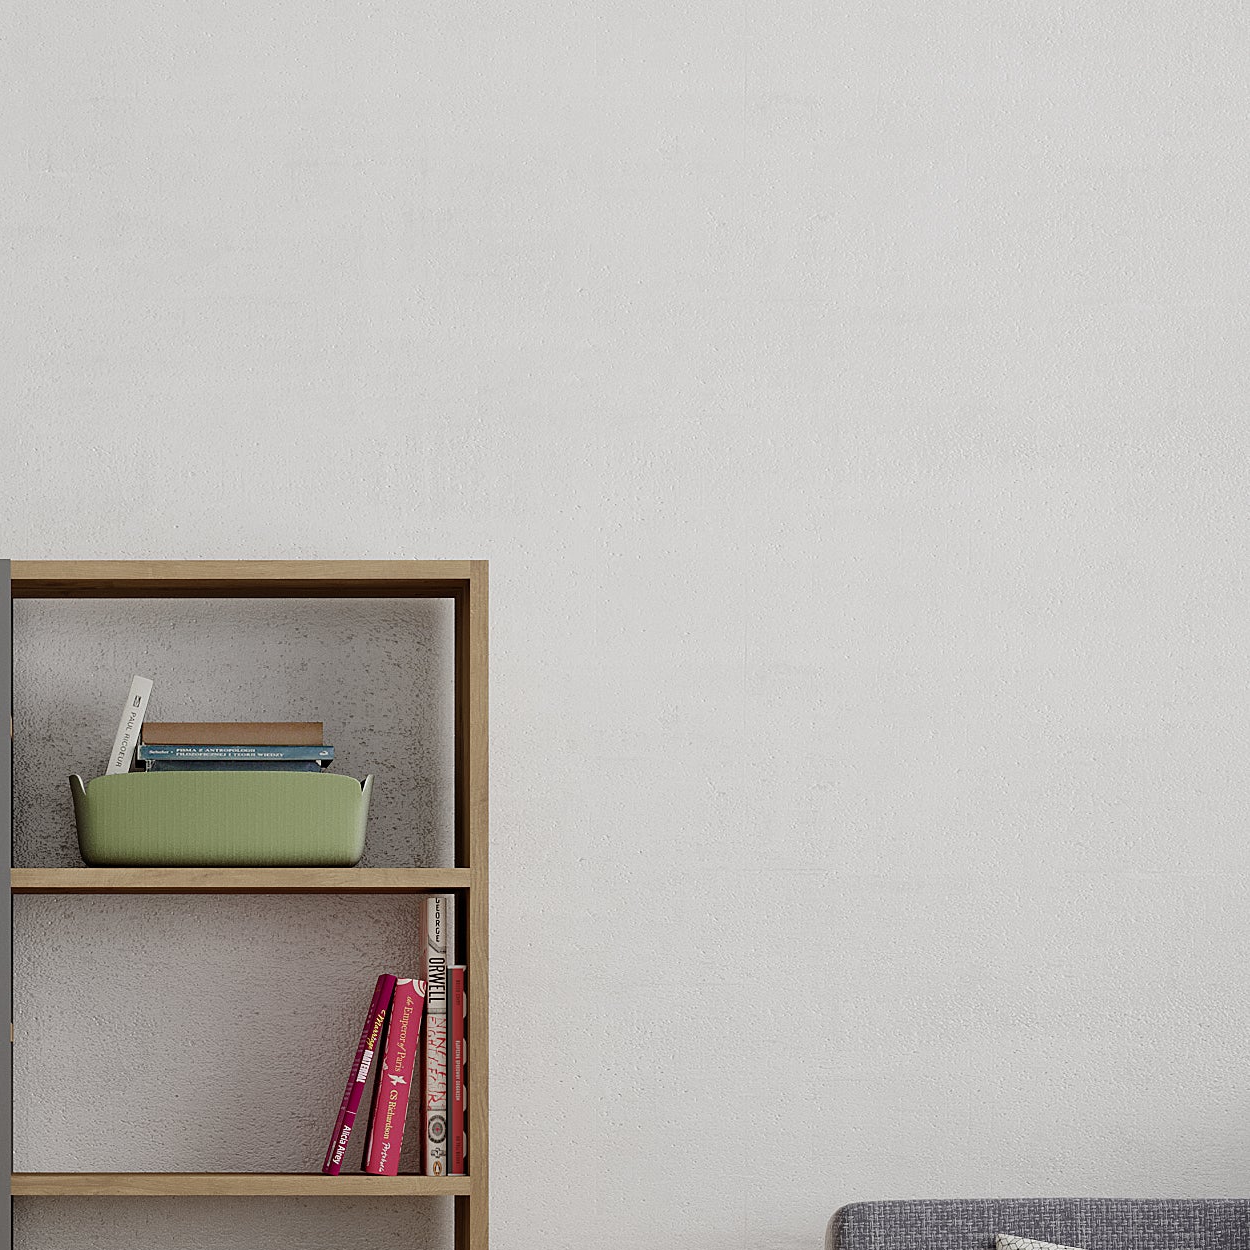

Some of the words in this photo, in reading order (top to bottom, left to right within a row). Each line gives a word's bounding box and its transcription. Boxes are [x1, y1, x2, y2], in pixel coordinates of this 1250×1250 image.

[126, 712, 137, 731] PAUL
[115, 733, 131, 768] RICOEUR
[429, 958, 445, 1003] ORWELL
[367, 1010, 386, 1050] Marriage
[399, 1007, 413, 1042] Emperor
[397, 1043, 406, 1051] of
[356, 1050, 373, 1083] MATERIAL
[395, 1052, 406, 1071] Paris
[390, 1090, 398, 1100] CS
[384, 1102, 396, 1139] Richardson
[339, 1125, 351, 1144] Alicia
[333, 1145, 345, 1164] Airey
